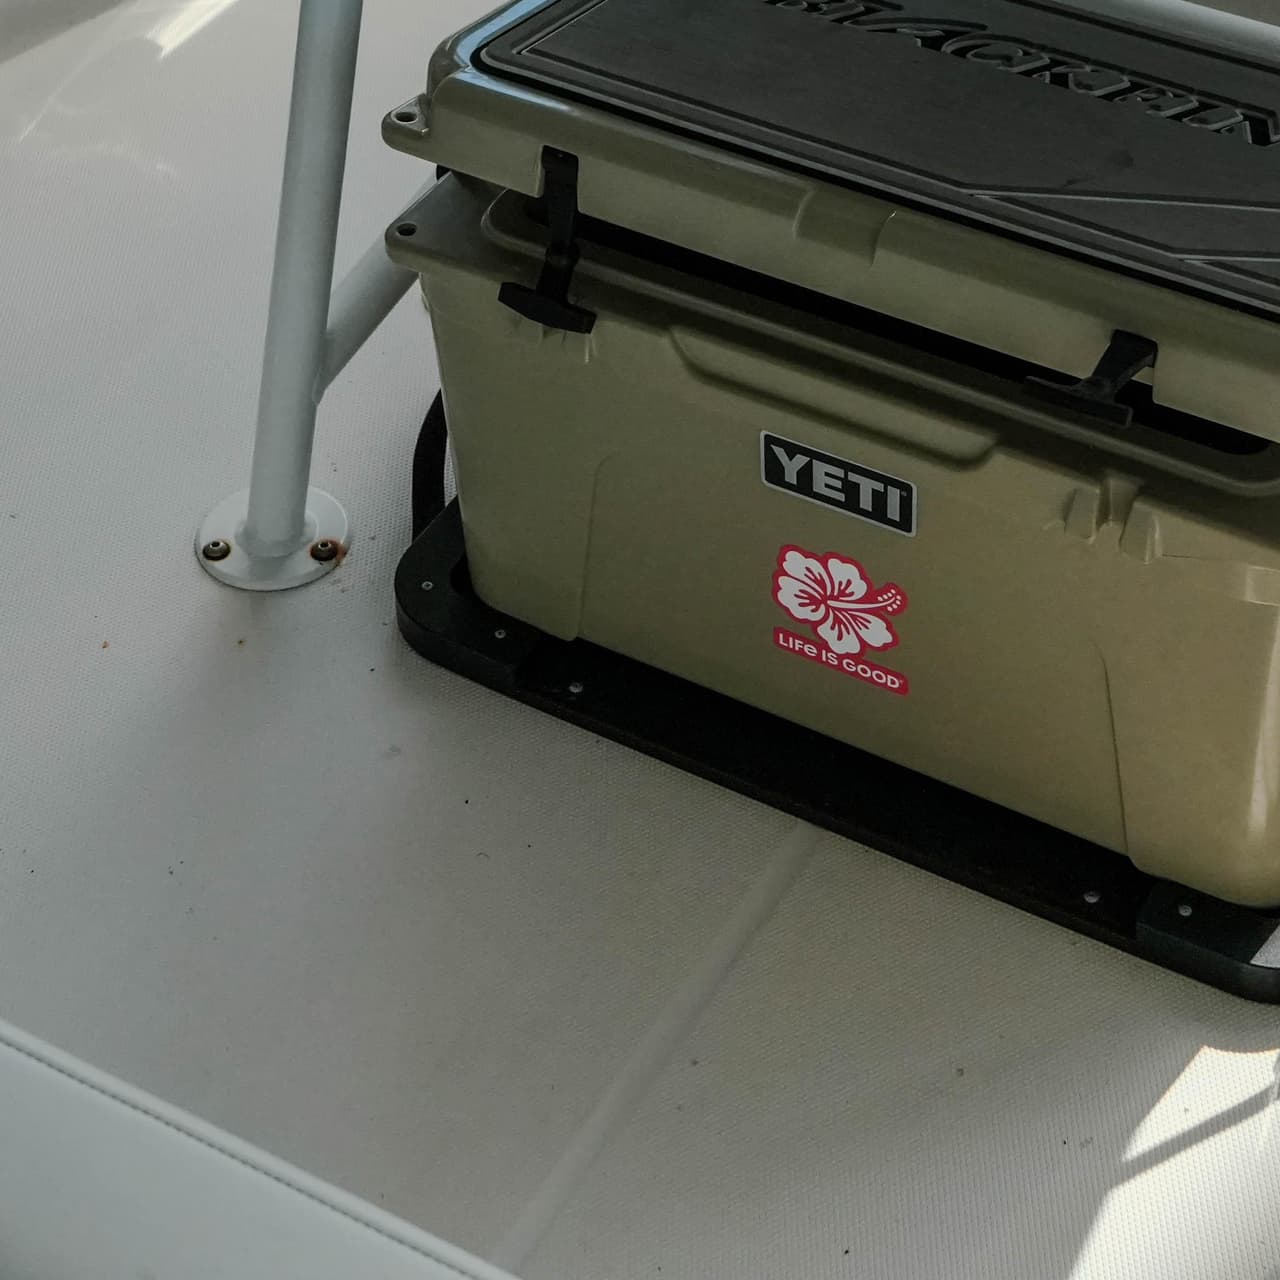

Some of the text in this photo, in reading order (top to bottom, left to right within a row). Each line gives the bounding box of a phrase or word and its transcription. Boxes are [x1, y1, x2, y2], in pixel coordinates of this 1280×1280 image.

[770, 443, 901, 522] YETI
[822, 648, 839, 666] IS
[842, 658, 900, 690] GOOD
